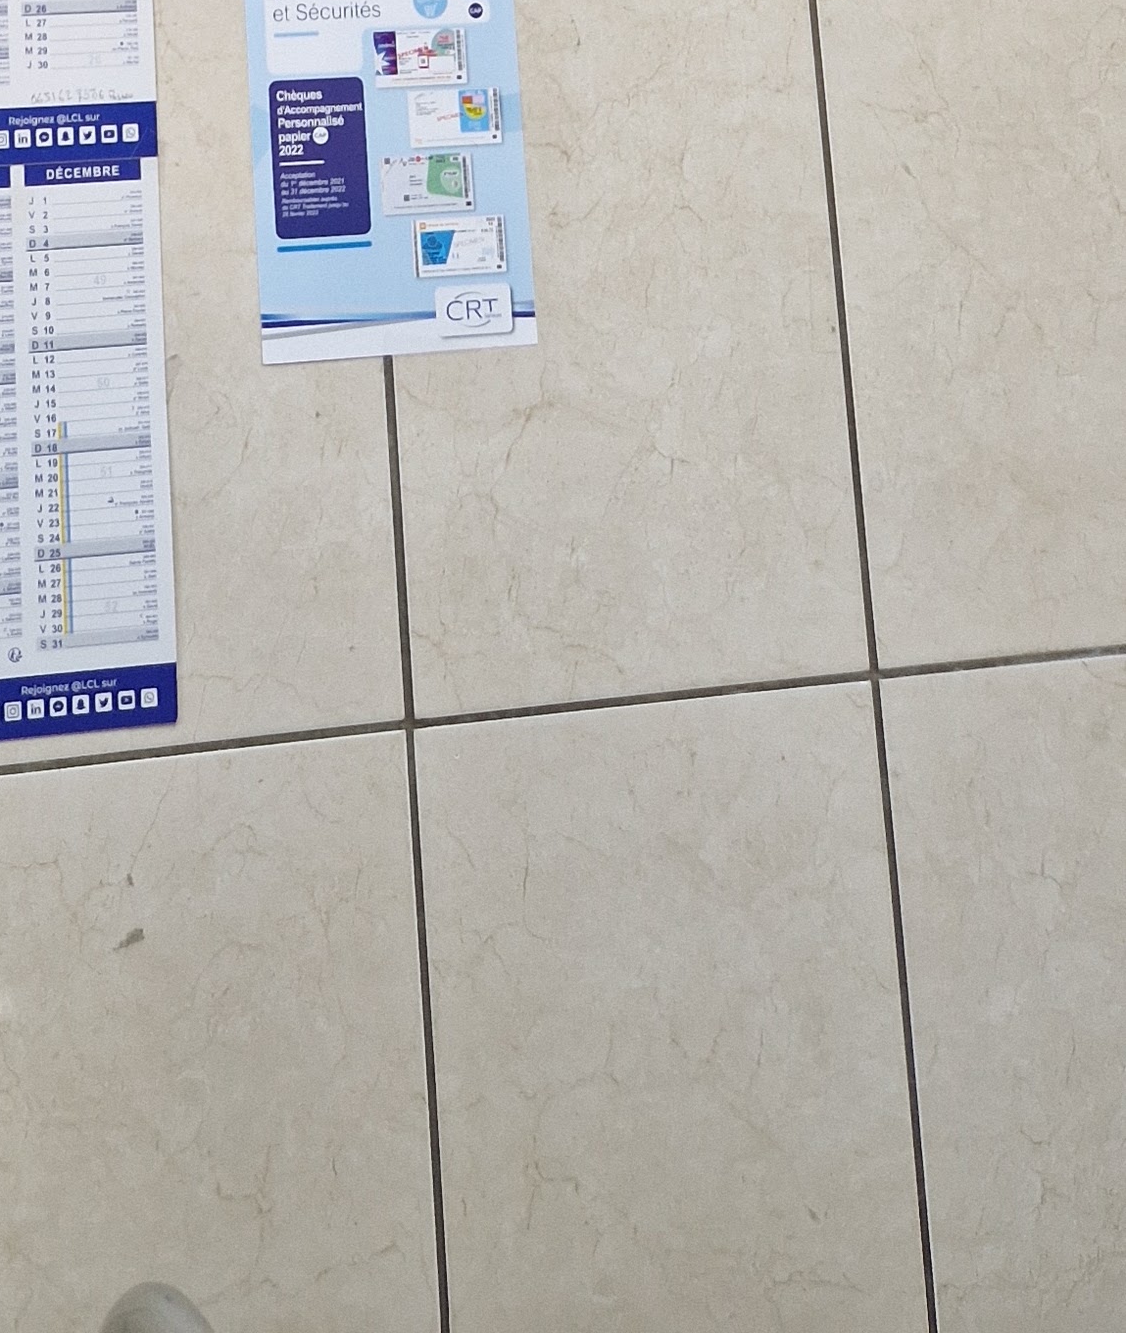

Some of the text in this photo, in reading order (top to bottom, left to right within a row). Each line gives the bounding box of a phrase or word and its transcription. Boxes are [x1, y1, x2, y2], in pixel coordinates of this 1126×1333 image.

[273, 1, 381, 22] et Sécurités
[276, 89, 322, 102] Chèques
[277, 101, 363, 116] d'Accompagnement
[9, 112, 101, 126] Rejoignez @LCL sur
[278, 115, 344, 128] Personnalisé
[279, 130, 312, 144] papier
[279, 144, 304, 156] 2022
[46, 164, 120, 179] DÉCEMBRE
[446, 297, 499, 322] CRT
